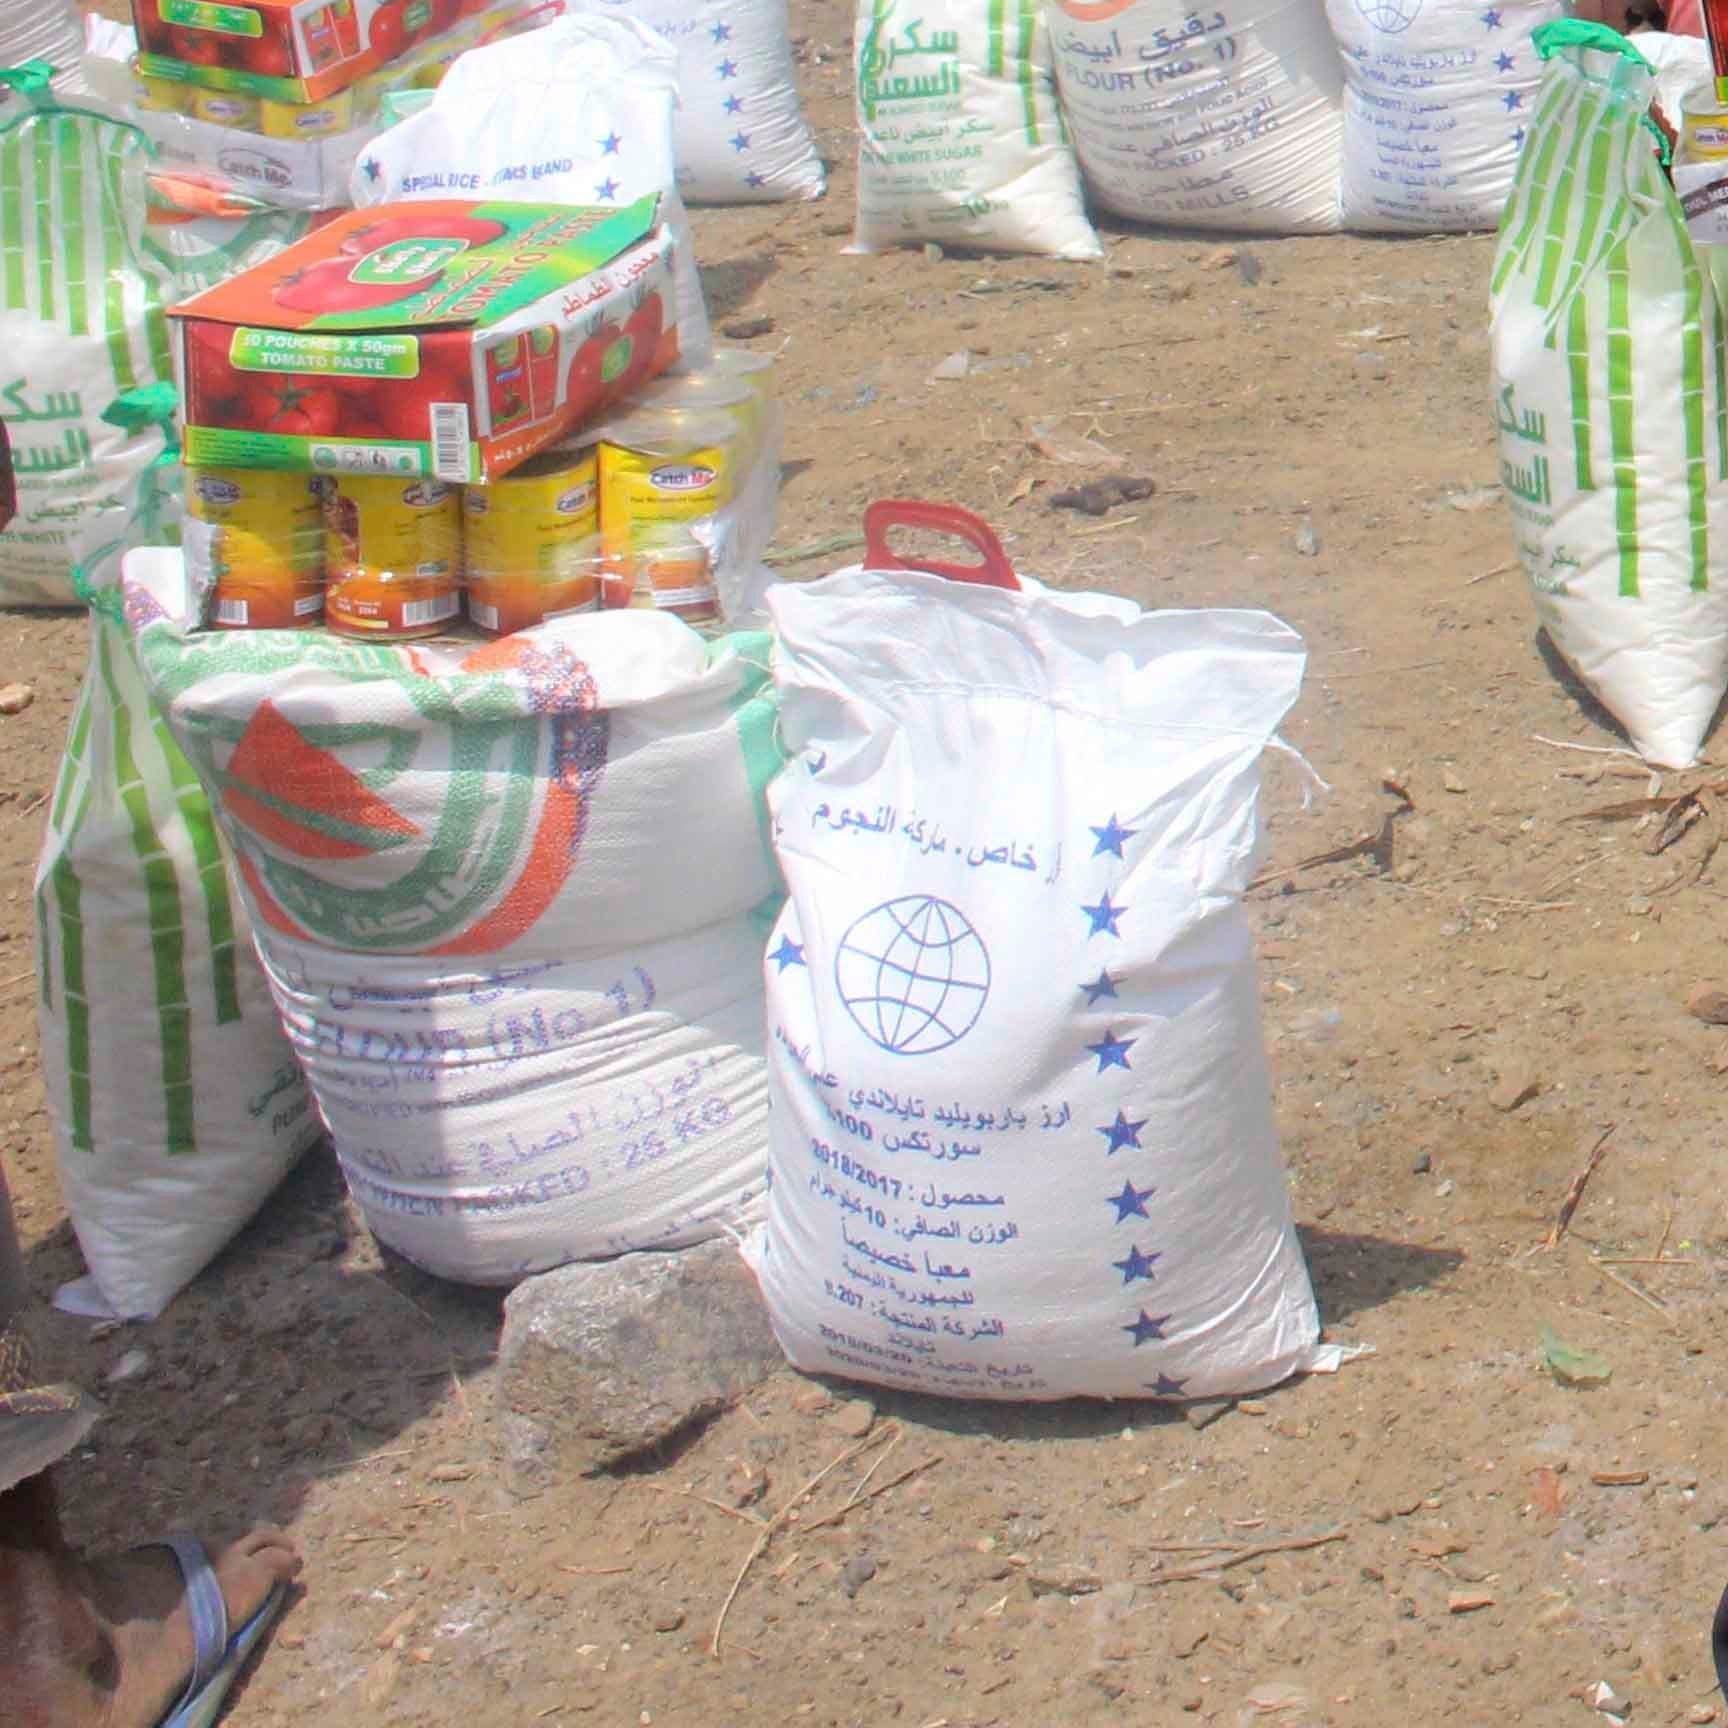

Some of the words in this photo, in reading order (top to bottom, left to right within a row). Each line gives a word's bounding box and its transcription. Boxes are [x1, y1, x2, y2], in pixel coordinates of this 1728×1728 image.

[887, 16, 960, 71] سكر
[1138, 10, 1228, 61] دقيق
[933, 144, 985, 161] SUGAR
[264, 334, 343, 354] POUCHES
[360, 339, 408, 358] 50gm
[260, 352, 328, 370] TOMATO
[332, 354, 387, 372] PASTE
[811, 801, 898, 835] النجوم
[921, 1183, 1005, 1210] محصول
[864, 1204, 886, 1228] 10
[967, 1221, 1019, 1244] الوزن
